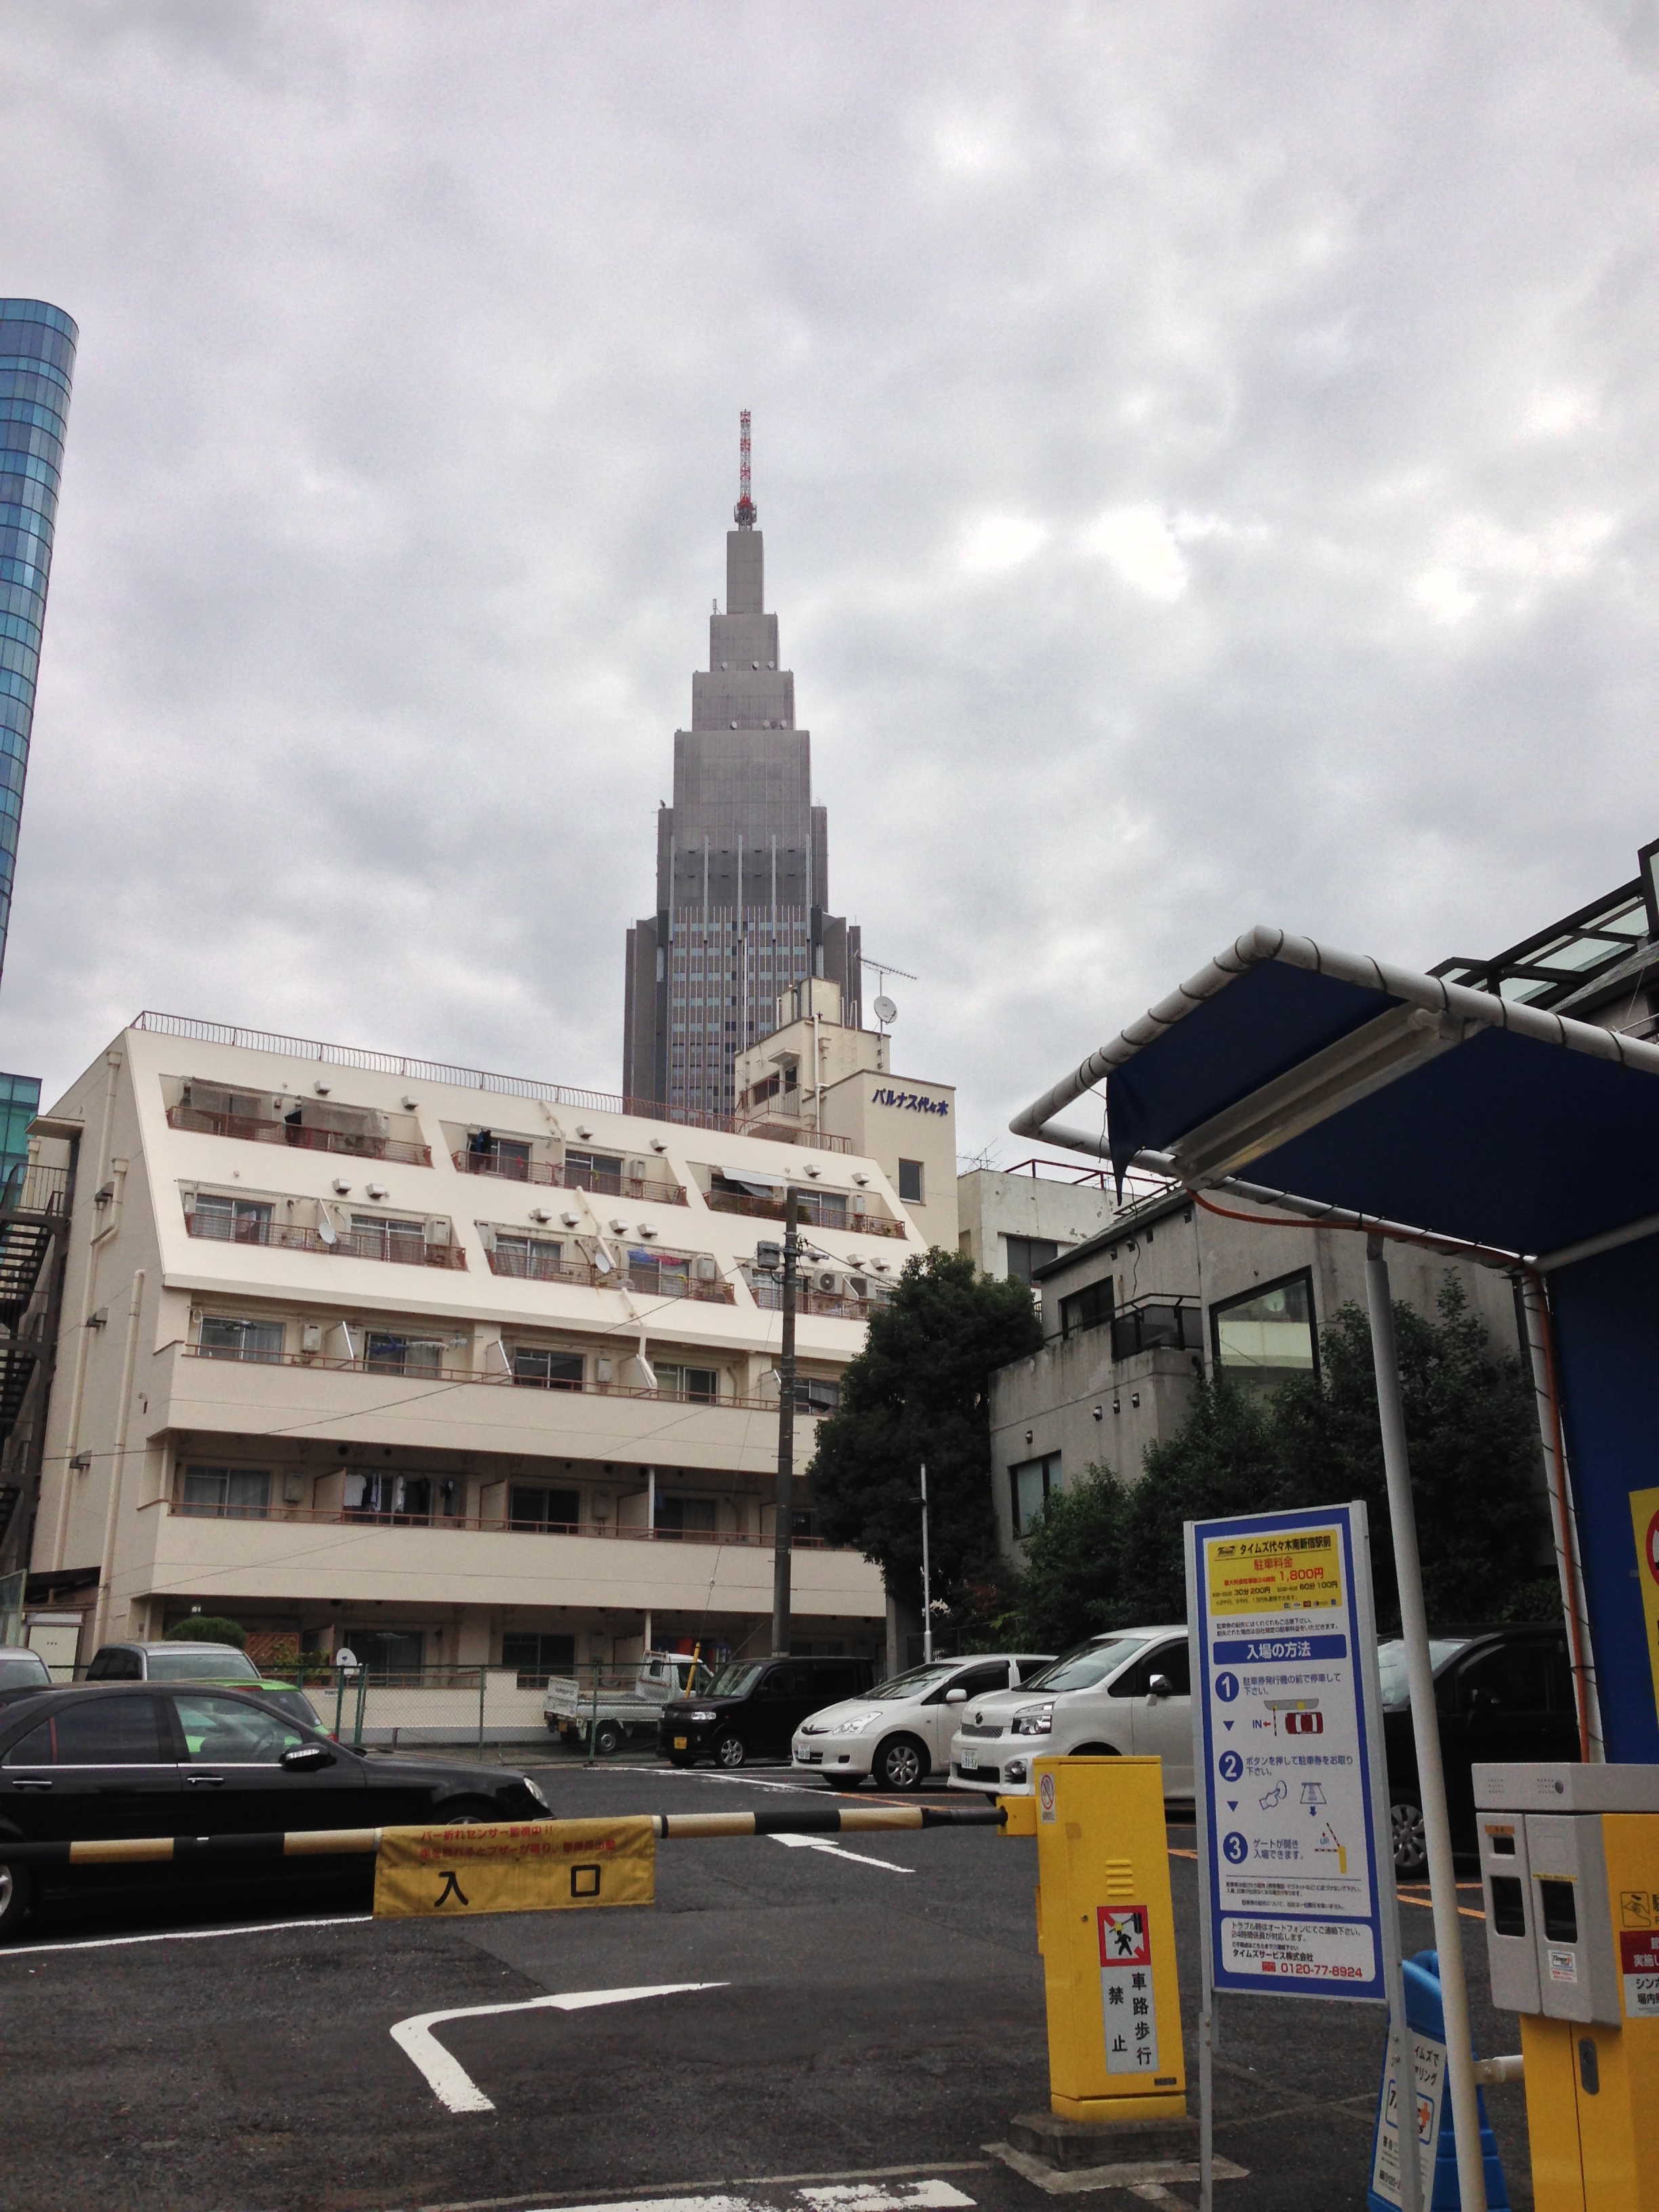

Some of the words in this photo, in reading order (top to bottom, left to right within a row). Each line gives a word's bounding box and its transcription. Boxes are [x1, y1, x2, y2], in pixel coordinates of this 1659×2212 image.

[872, 1088, 949, 1117] パルナス代々木
[1254, 1557, 1294, 1571] 駐車料金
[1279, 1568, 1324, 1582] 1,800円
[1250, 1586, 1271, 1595] 200円
[1317, 1580, 1338, 1589] 100円
[1247, 1641, 1311, 1660] 入場の方法
[1222, 1676, 1231, 1698] 1
[1244, 1686, 1269, 1696] 下さい。
[1252, 1719, 1262, 1728] IN
[1225, 1755, 1237, 1777] 2
[1246, 1767, 1273, 1776] 下さい。
[1229, 1836, 1242, 1860] 3
[1254, 1849, 1304, 1860] 入場できます。
[1233, 1948, 1314, 1963] タイムズサービス株式会社
[1281, 1963, 1363, 1978] 0120-77-8924
[1109, 1986, 1128, 2052] 禁止
[1132, 1972, 1151, 2065] 車路歩行
[1415, 2046, 1439, 2067] イムズで
